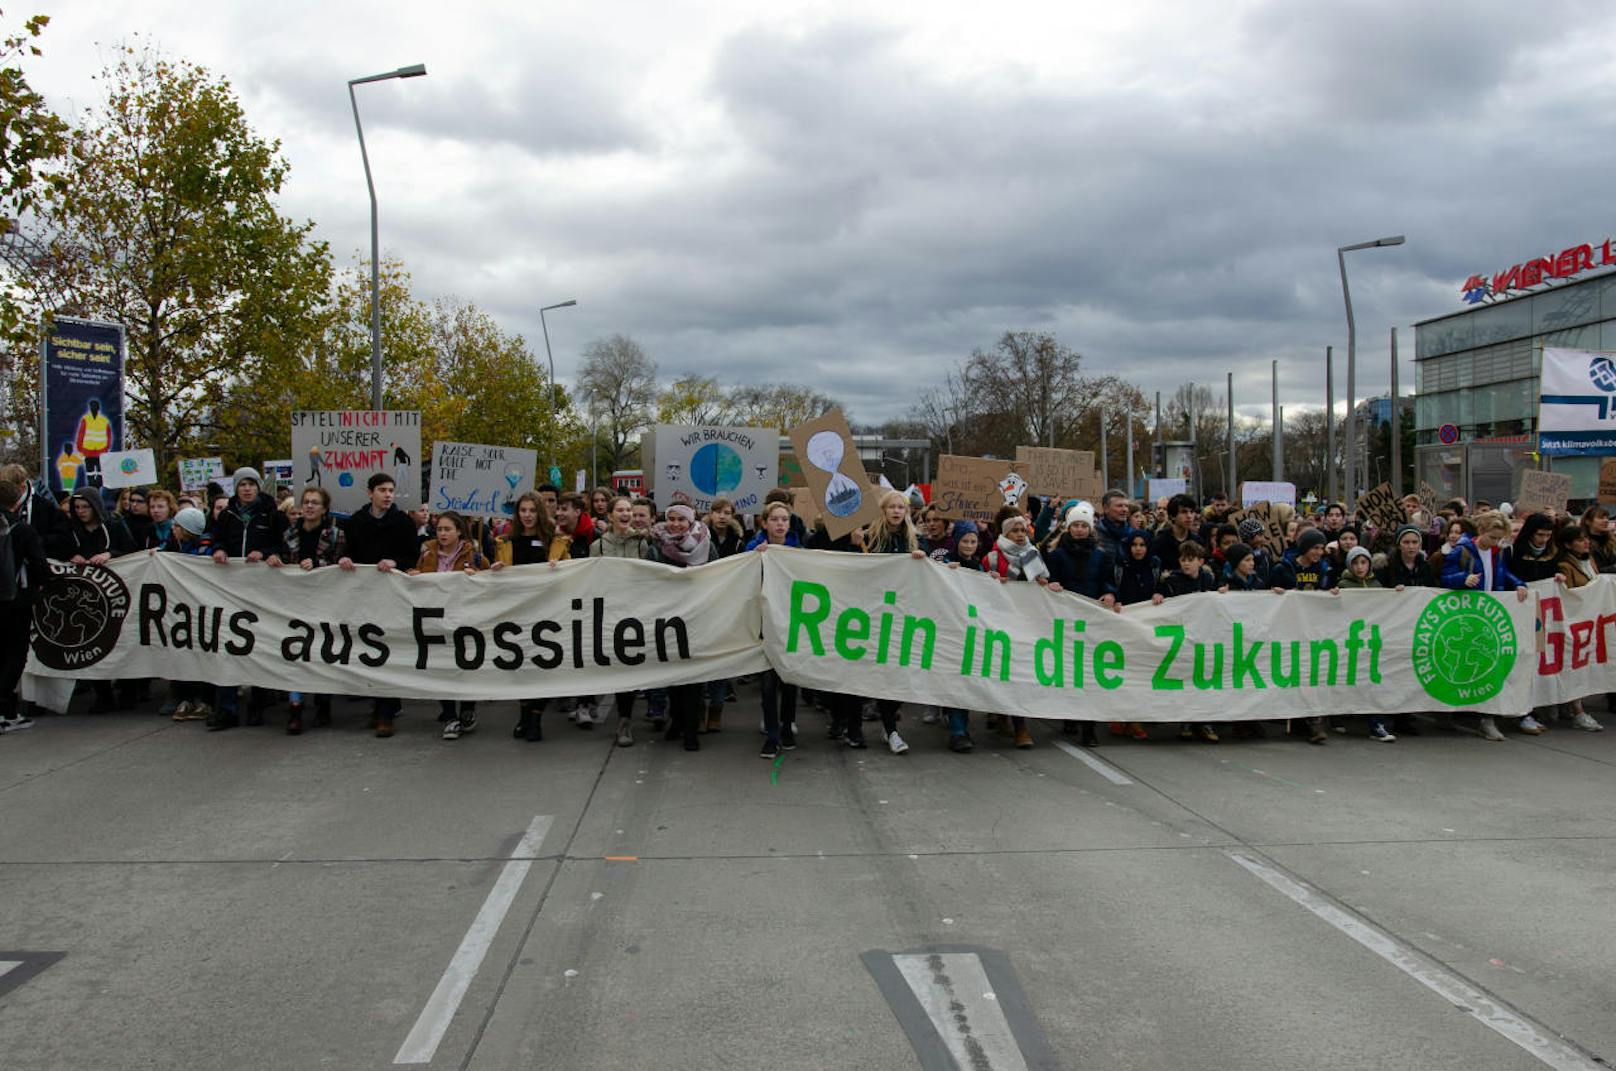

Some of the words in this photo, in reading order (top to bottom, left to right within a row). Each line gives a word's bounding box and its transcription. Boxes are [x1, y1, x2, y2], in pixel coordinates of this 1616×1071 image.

[1493, 243, 1597, 292] WIENER
[51, 336, 93, 350] Sichtbar
[57, 349, 88, 361] sicher
[291, 412, 342, 427] SPIELT
[342, 412, 388, 427] NICHT
[395, 412, 419, 427] MIT
[321, 431, 381, 447] UNSERER
[680, 432, 702, 447] WIR
[702, 429, 755, 451] BRAUCHEN
[324, 449, 389, 472] ZUKUNFT
[475, 458, 495, 470] NOT
[440, 467, 459, 480] THE
[1360, 484, 1394, 515] HOW
[83, 565, 126, 618] FUTURE
[139, 583, 259, 656] Raus
[280, 618, 391, 668] aus
[412, 596, 691, 670] Fossilen
[786, 580, 937, 670] Rein
[961, 604, 1012, 682] in
[1034, 618, 1125, 690] die
[1151, 618, 1383, 690] Zukunft
[1414, 610, 1440, 684] FRIDAYS
[1438, 593, 1473, 615] FOR
[1476, 596, 1515, 657] FUTURE
[64, 646, 102, 664] Wien
[1457, 683, 1495, 699] Wien
